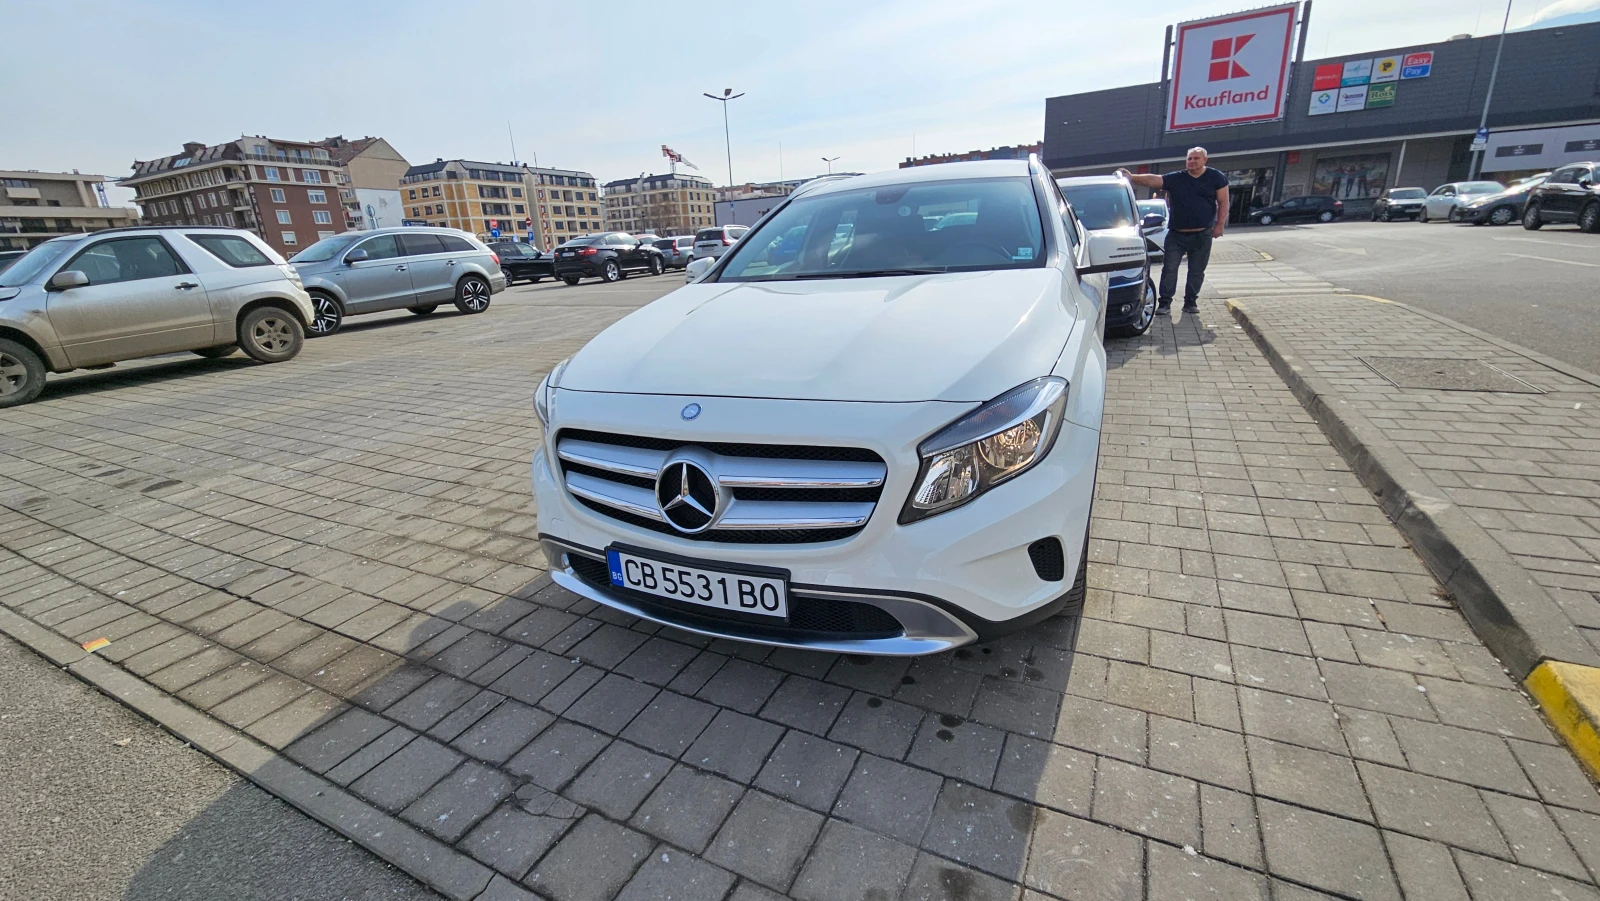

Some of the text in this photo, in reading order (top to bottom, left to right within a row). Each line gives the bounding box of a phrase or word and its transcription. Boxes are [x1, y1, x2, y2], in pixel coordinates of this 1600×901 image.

[1407, 57, 1429, 66] Easy
[1405, 67, 1422, 76] Pay
[1184, 85, 1269, 110] Kaufland
[612, 571, 623, 581] BG
[624, 559, 658, 590] CB
[661, 566, 729, 605] 5531
